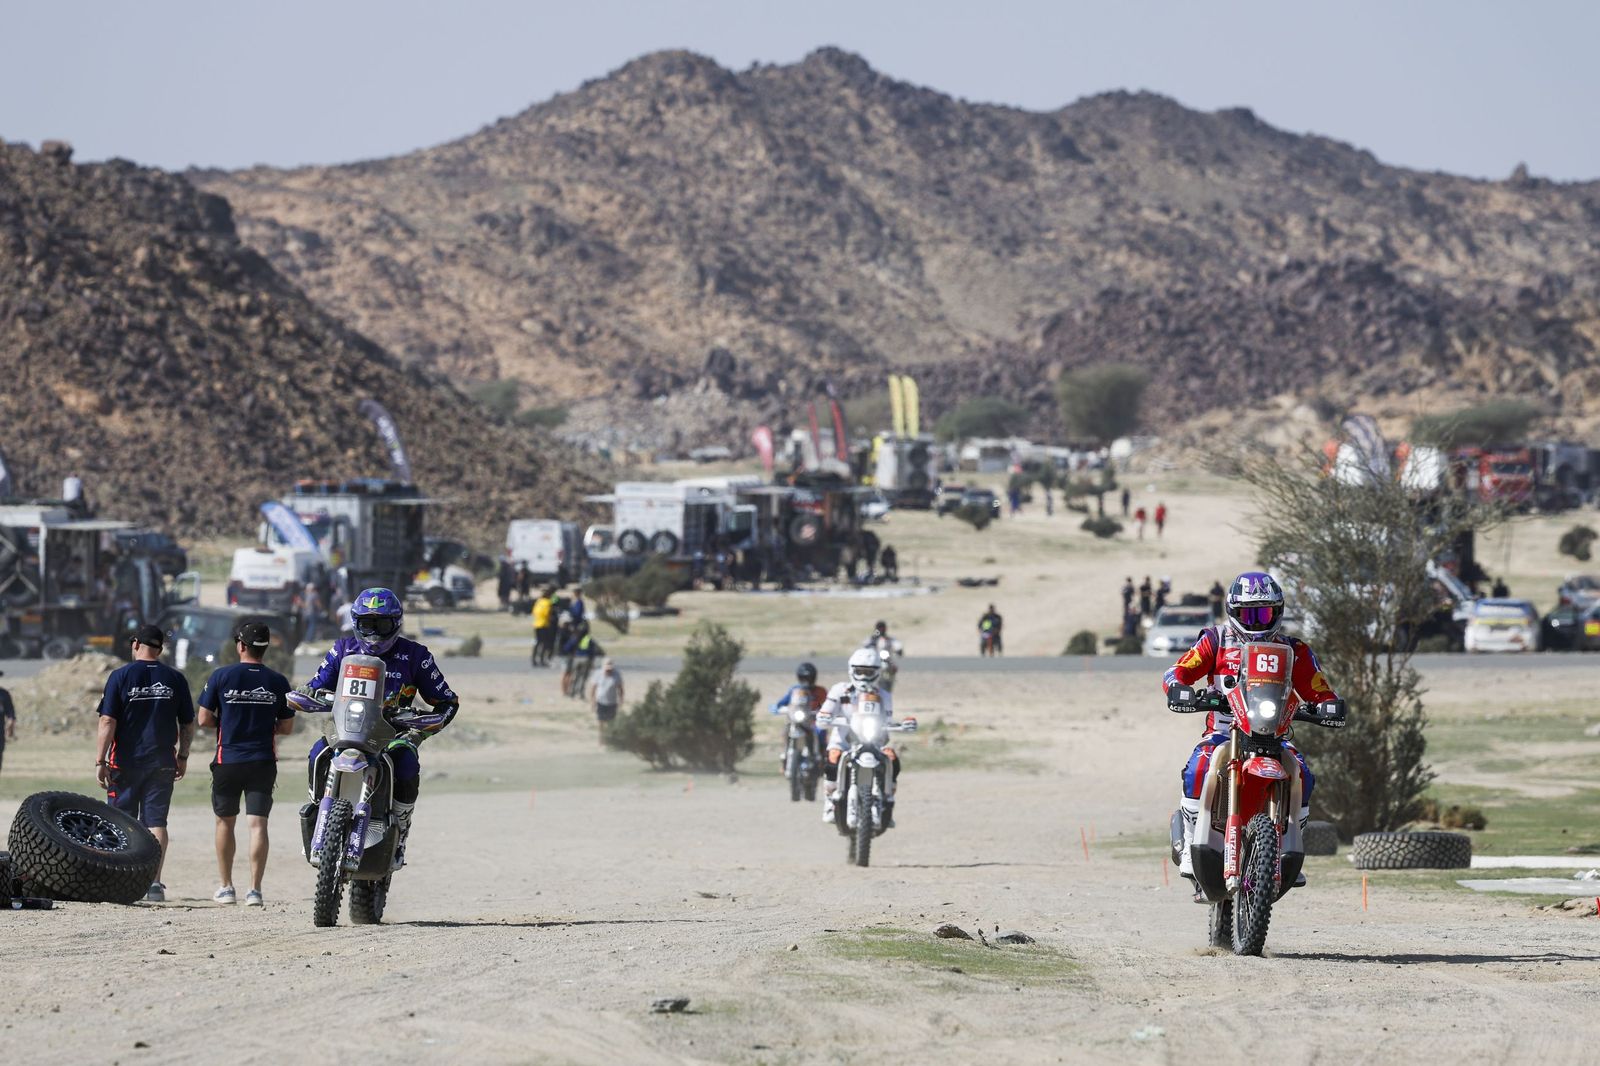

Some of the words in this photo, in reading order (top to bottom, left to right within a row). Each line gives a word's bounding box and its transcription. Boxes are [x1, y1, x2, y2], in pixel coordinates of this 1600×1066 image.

[1256, 653, 1279, 673] 63
[349, 679, 367, 696] 81
[864, 702, 875, 713] 67
[1229, 825, 1237, 872] METZELER
